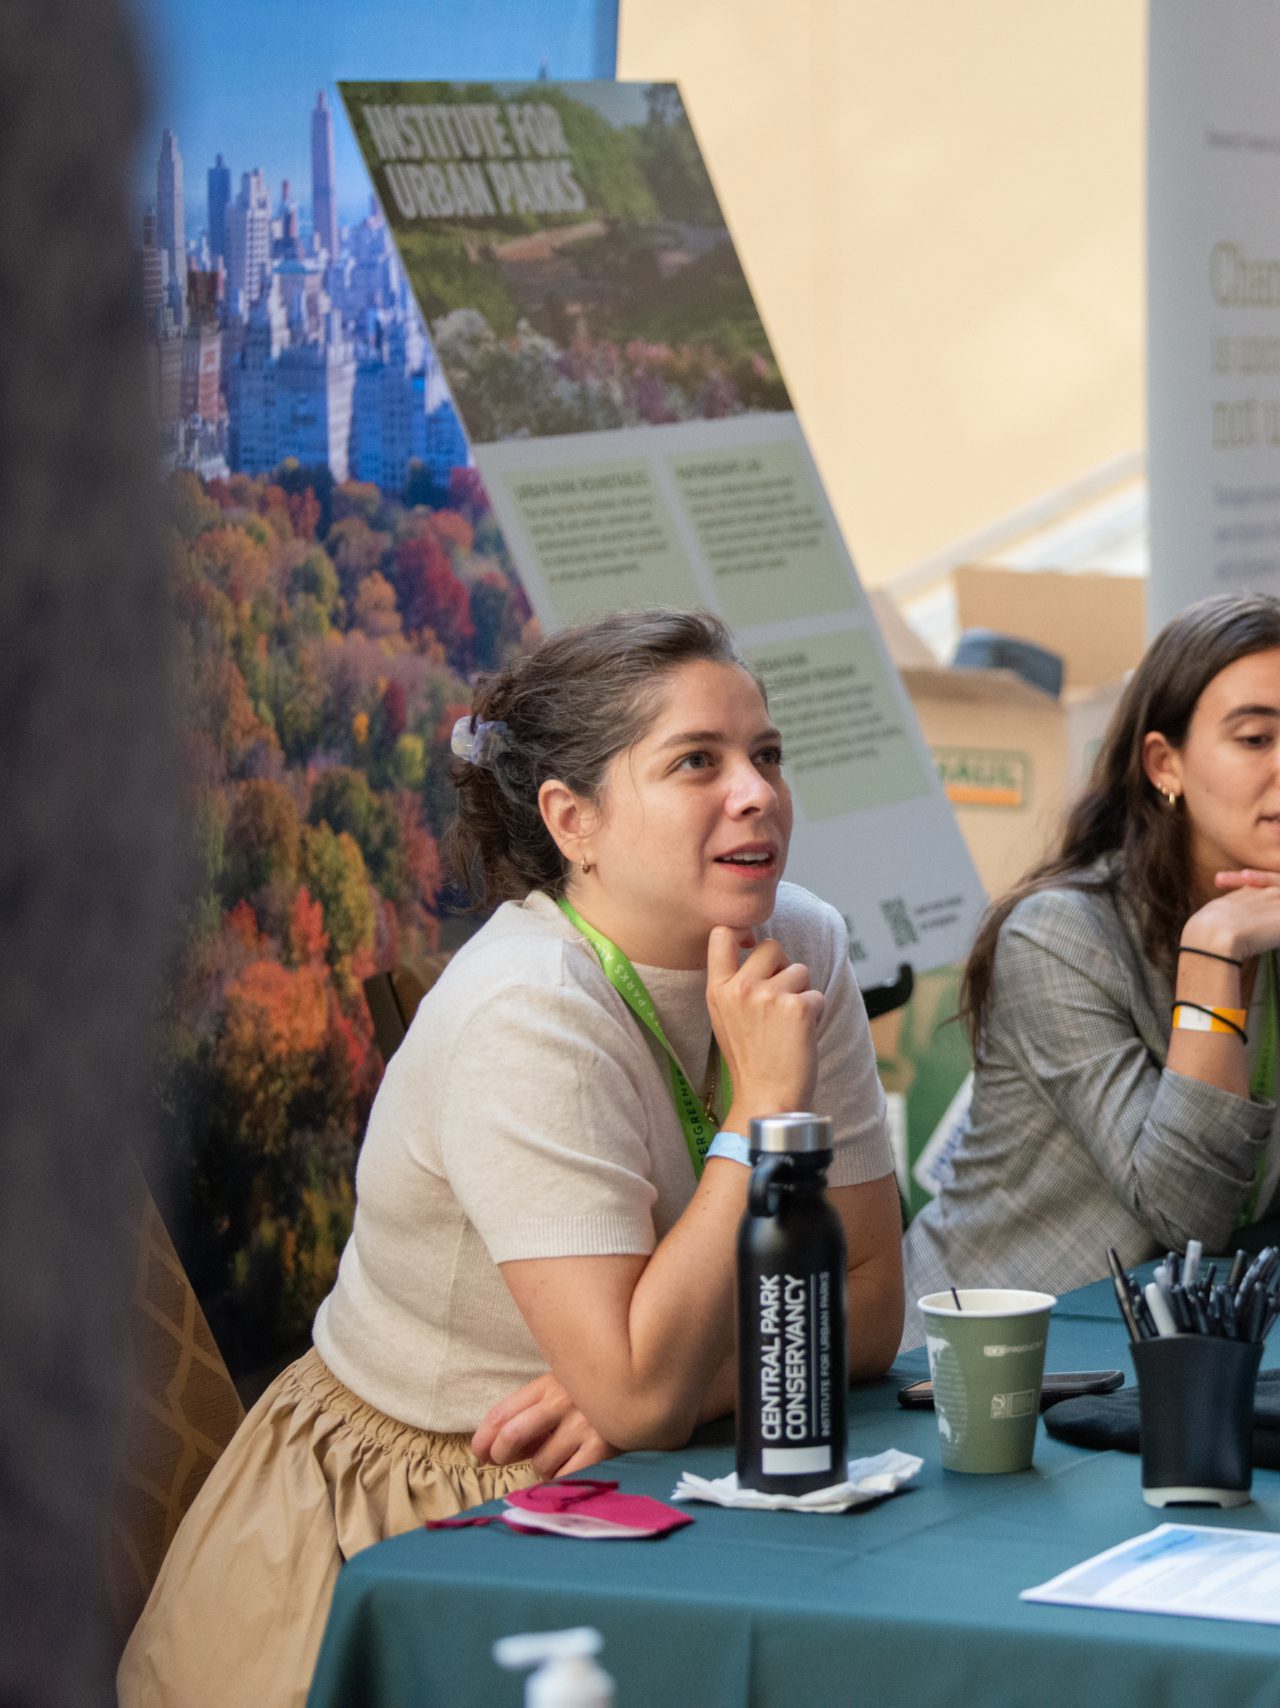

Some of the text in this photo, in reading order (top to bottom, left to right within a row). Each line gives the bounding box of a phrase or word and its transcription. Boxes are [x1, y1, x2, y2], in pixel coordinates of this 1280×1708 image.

[363, 101, 572, 160] INSTITUTE FOR
[383, 158, 585, 220] URBAN PARKS
[613, 963, 647, 1008] PARKS
[759, 1273, 782, 1441] CENTRAL PARK
[784, 1273, 808, 1441] CONSERVANCY
[818, 1270, 831, 1438] INSTITUTE FOR URBAN PARKS
